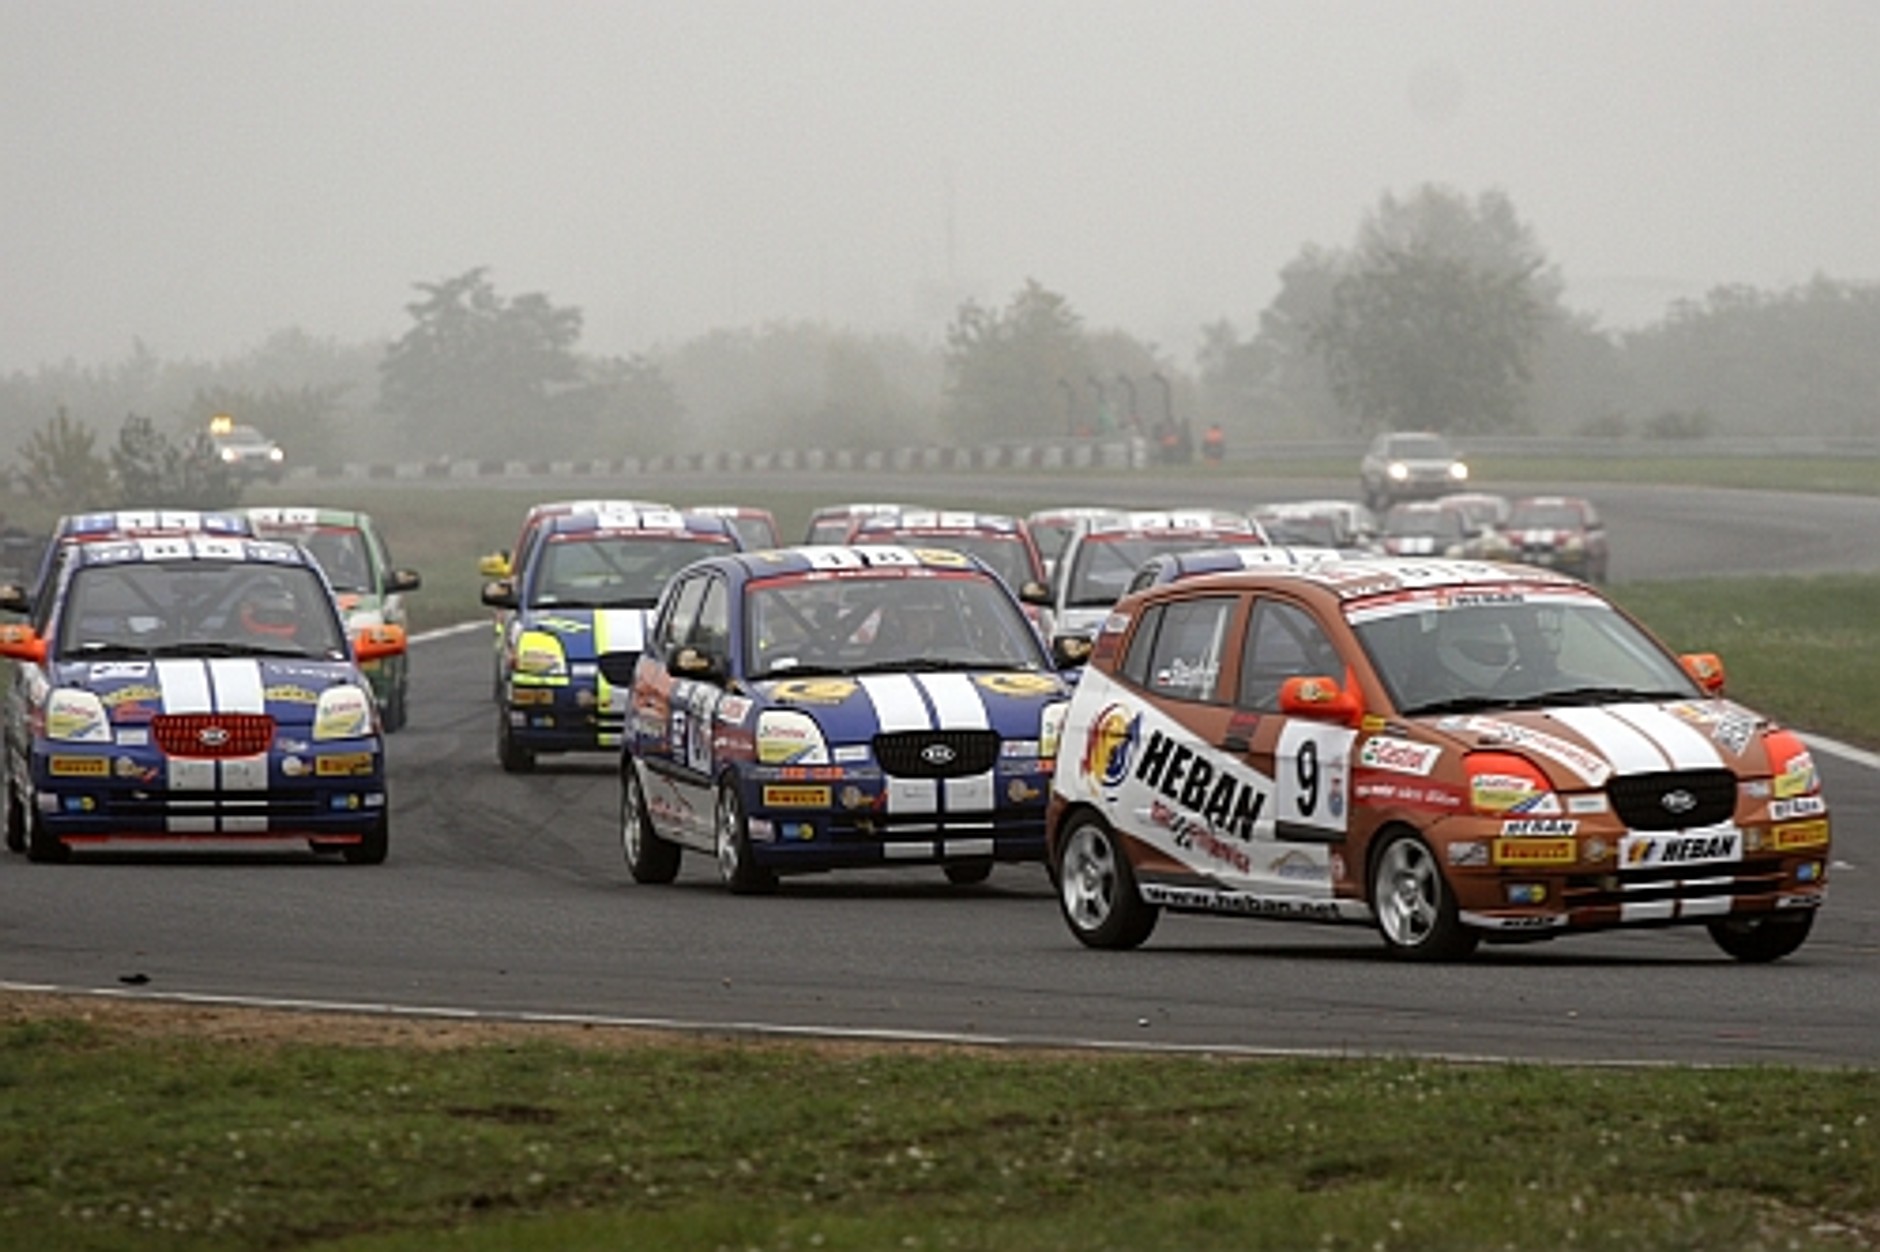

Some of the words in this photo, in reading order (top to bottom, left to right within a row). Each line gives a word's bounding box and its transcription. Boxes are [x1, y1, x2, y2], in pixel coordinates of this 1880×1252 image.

[1136, 730, 1267, 843] HEBAN
[1297, 739, 1319, 818] 9
[1660, 836, 1738, 862] HEBAN
